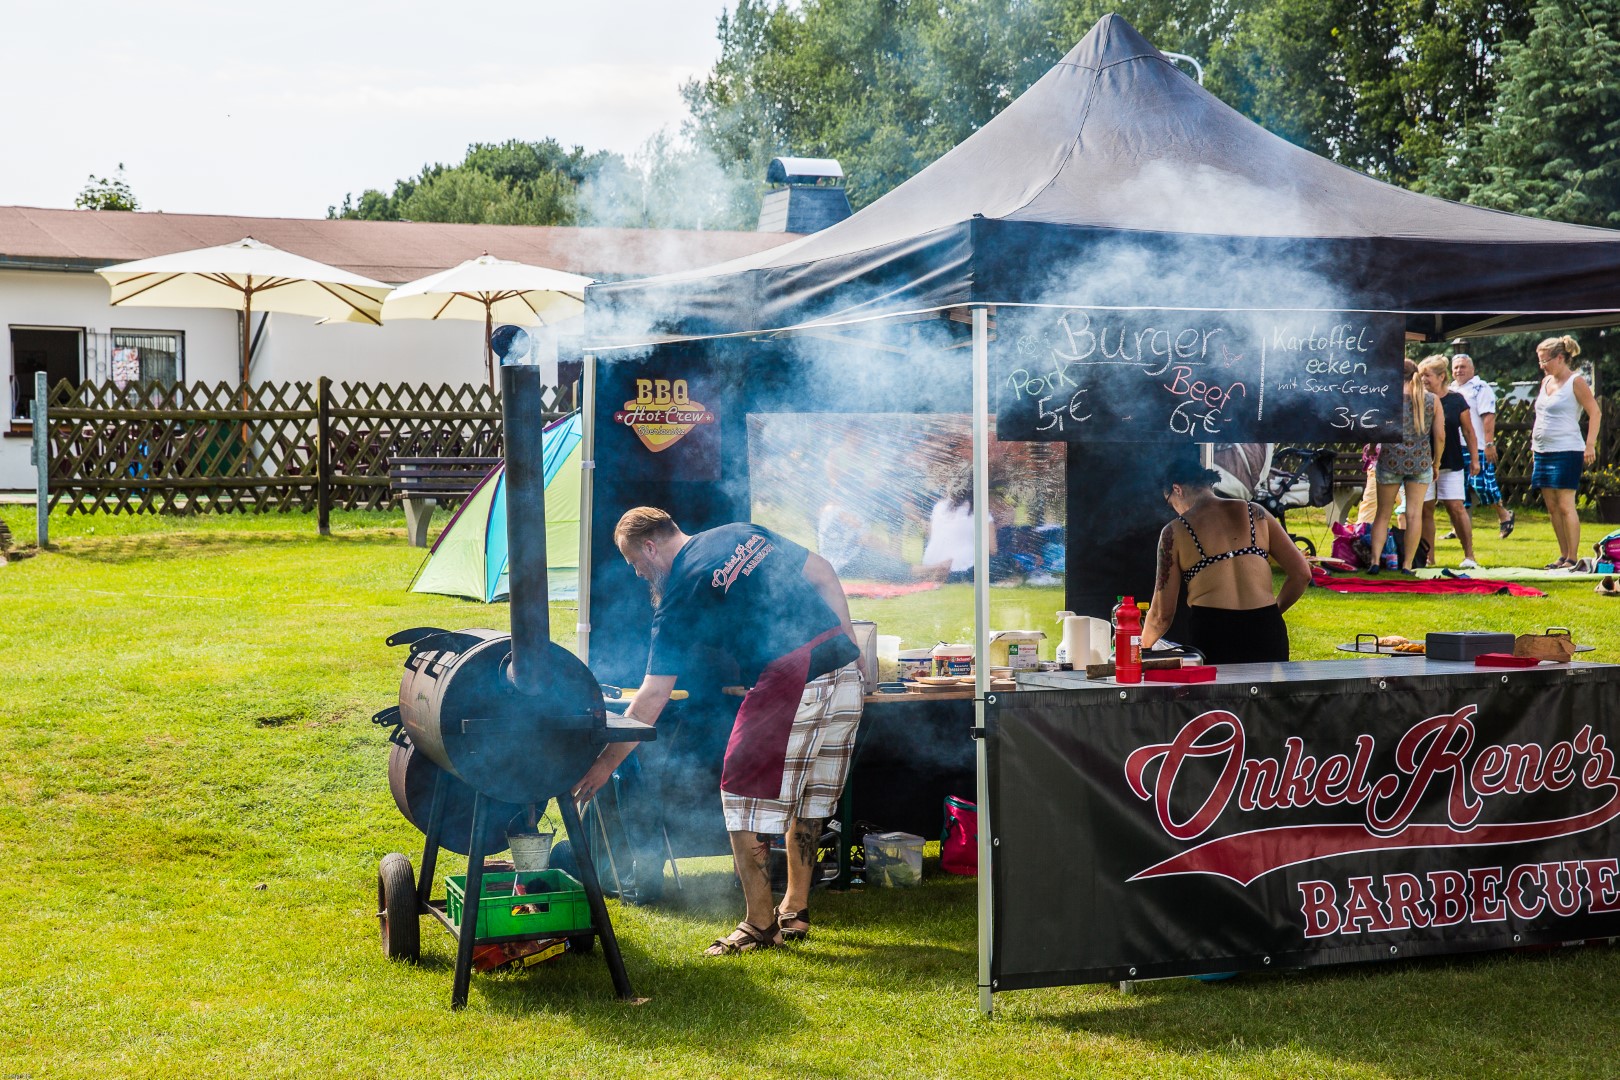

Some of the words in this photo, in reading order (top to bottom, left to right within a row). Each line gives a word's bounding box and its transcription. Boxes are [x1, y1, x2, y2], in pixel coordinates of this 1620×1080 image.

[1055, 309, 1223, 377] Burger
[1273, 324, 1374, 352] Kartoffel-
[1006, 352, 1079, 400] Pork
[1277, 377, 1298, 391] mit
[1305, 353, 1368, 375] ecken
[636, 378, 691, 405] BBQ
[1164, 366, 1246, 409] Beef
[1124, 709, 1375, 840] Onkel
[1366, 704, 1620, 830] Rene's
[1297, 858, 1620, 939] BARBECUE
